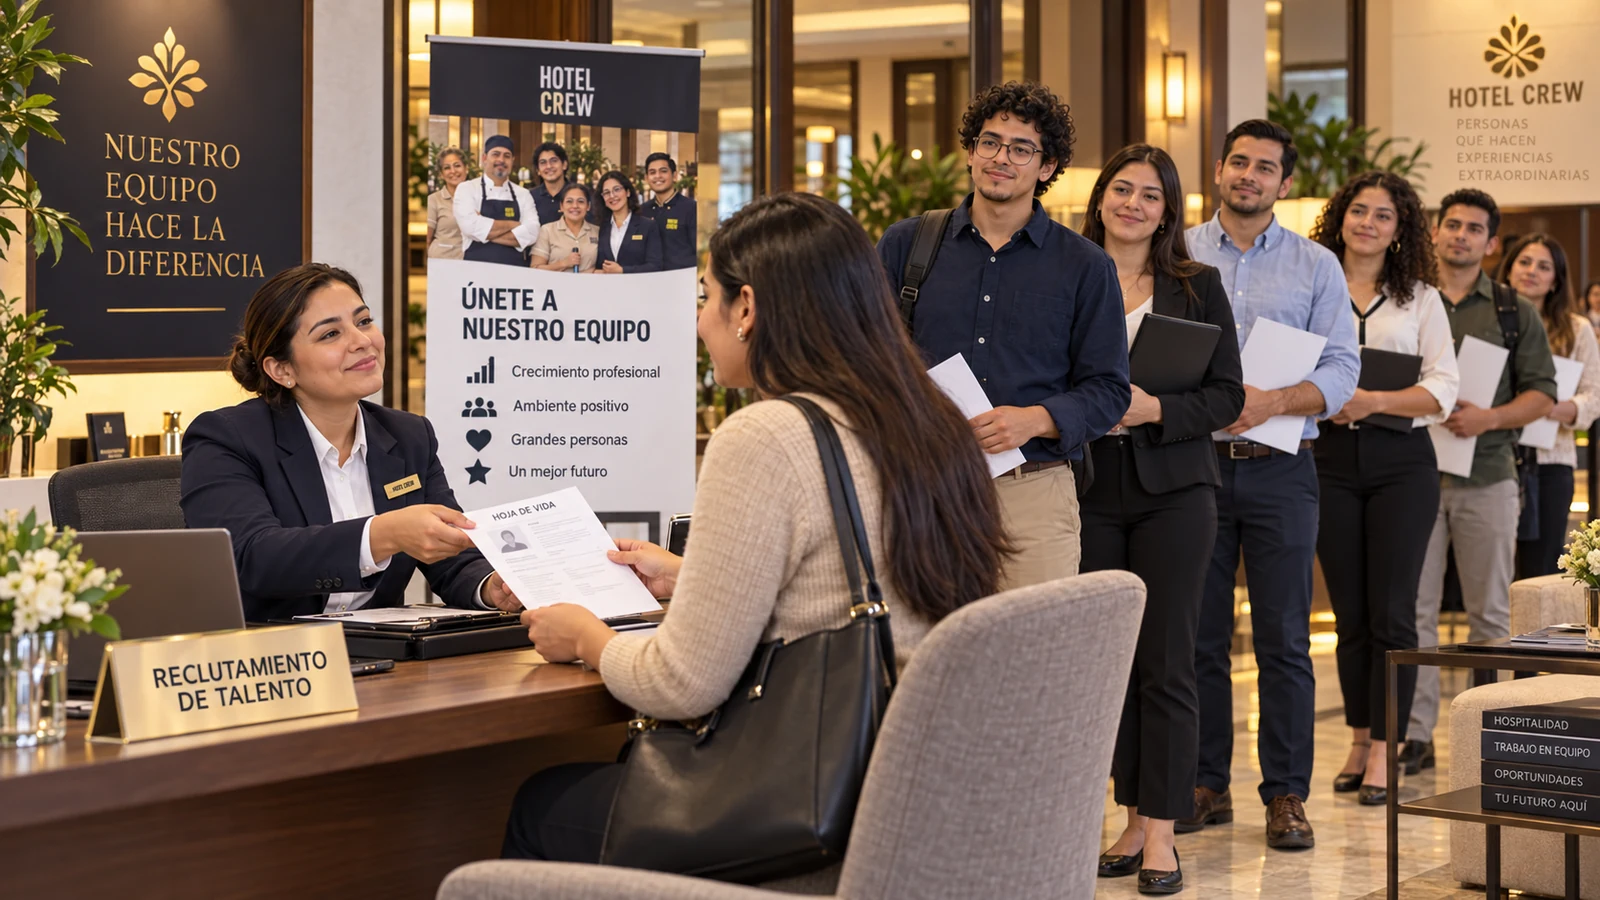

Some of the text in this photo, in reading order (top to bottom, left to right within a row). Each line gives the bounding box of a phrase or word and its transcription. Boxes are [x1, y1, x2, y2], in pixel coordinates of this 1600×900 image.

[540, 66, 595, 92] HOTEL
[1449, 81, 1583, 108] HOTEL CREW
[541, 91, 594, 117] CREW
[1457, 118, 1528, 129] PERSONAS
[1490, 135, 1535, 146] HACEN
[105, 133, 240, 169] NUESTRO
[1457, 152, 1553, 163] EXPERIENCIAS
[1459, 170, 1589, 181] EXTRAORDINARIAS
[106, 172, 216, 205] EQUIPO
[106, 212, 225, 241] HACE LA
[107, 250, 264, 277] DIFERENCIA
[462, 282, 557, 311] ÚNETE A
[463, 318, 650, 344] NUESTRO EQUIPO
[512, 365, 660, 380] Crecimiento profesional
[513, 400, 628, 415] Ambiente positivo
[512, 433, 627, 448] Grandes personas
[509, 465, 607, 480] Un mejor futuro
[492, 501, 556, 520] HOJA DE VIDA
[153, 650, 328, 688] RECLUTAMIENTO
[178, 677, 312, 712] DE TALENTO
[1493, 716, 1569, 730] HOSPITALIDAD
[1494, 742, 1590, 758] TRABAJO EN EQUIPO
[1494, 769, 1583, 787] OPORTUNIDADES
[1495, 793, 1587, 811] TU FUTURO AQUÍ
